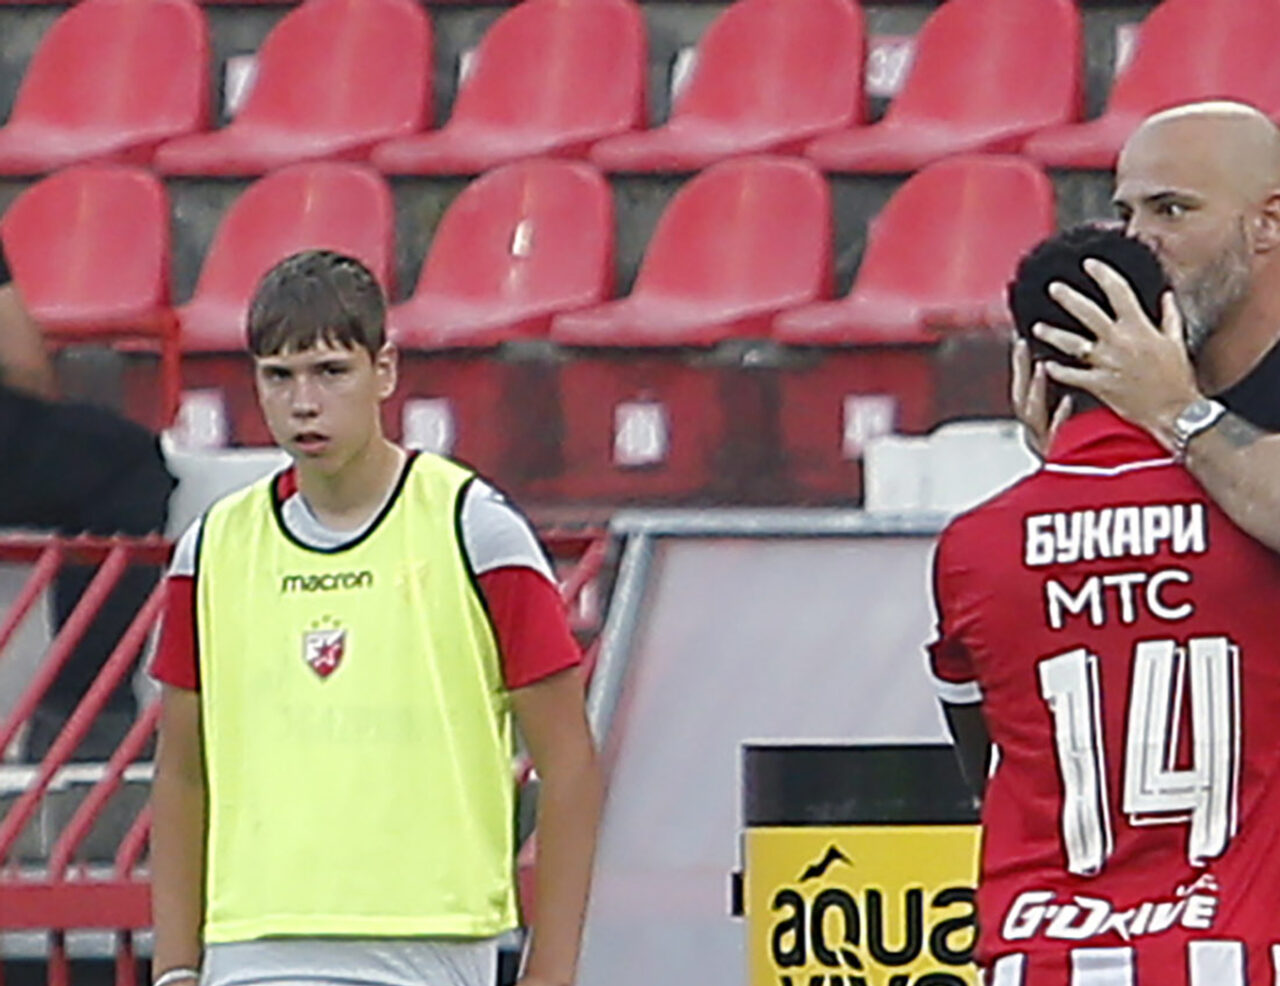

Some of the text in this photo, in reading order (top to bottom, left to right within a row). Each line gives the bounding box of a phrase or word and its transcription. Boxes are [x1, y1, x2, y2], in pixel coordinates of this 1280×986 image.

[1025, 503, 1206, 566] БУКАРИ
[281, 570, 373, 592] macron
[1046, 568, 1194, 629] МТС
[1038, 636, 1241, 877] 14
